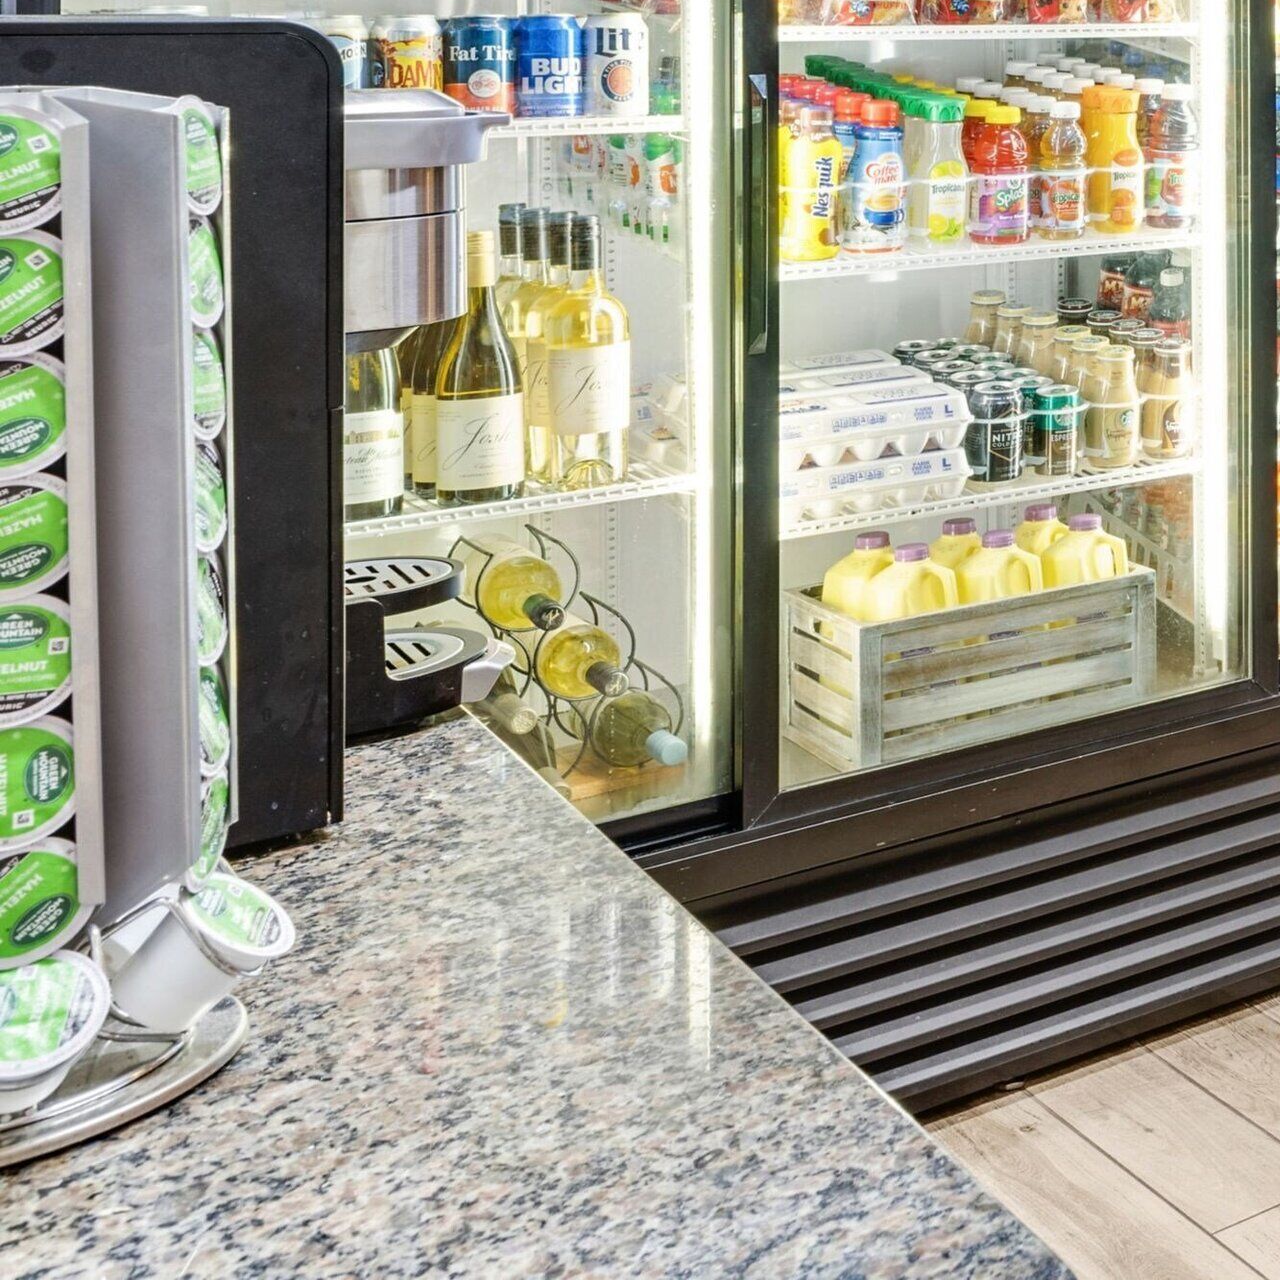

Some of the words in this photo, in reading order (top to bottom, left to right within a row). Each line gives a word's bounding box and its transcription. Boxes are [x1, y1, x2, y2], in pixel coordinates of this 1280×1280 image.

[449, 46, 478, 61] Fat
[532, 57, 581, 76] BUD
[521, 76, 583, 95] LIGHT
[866, 154, 901, 179] Coffee
[943, 404, 953, 415] L
[942, 457, 951, 468] L
[37, 750, 48, 803] MOUNTAIN
[47, 756, 60, 790] GREEN
